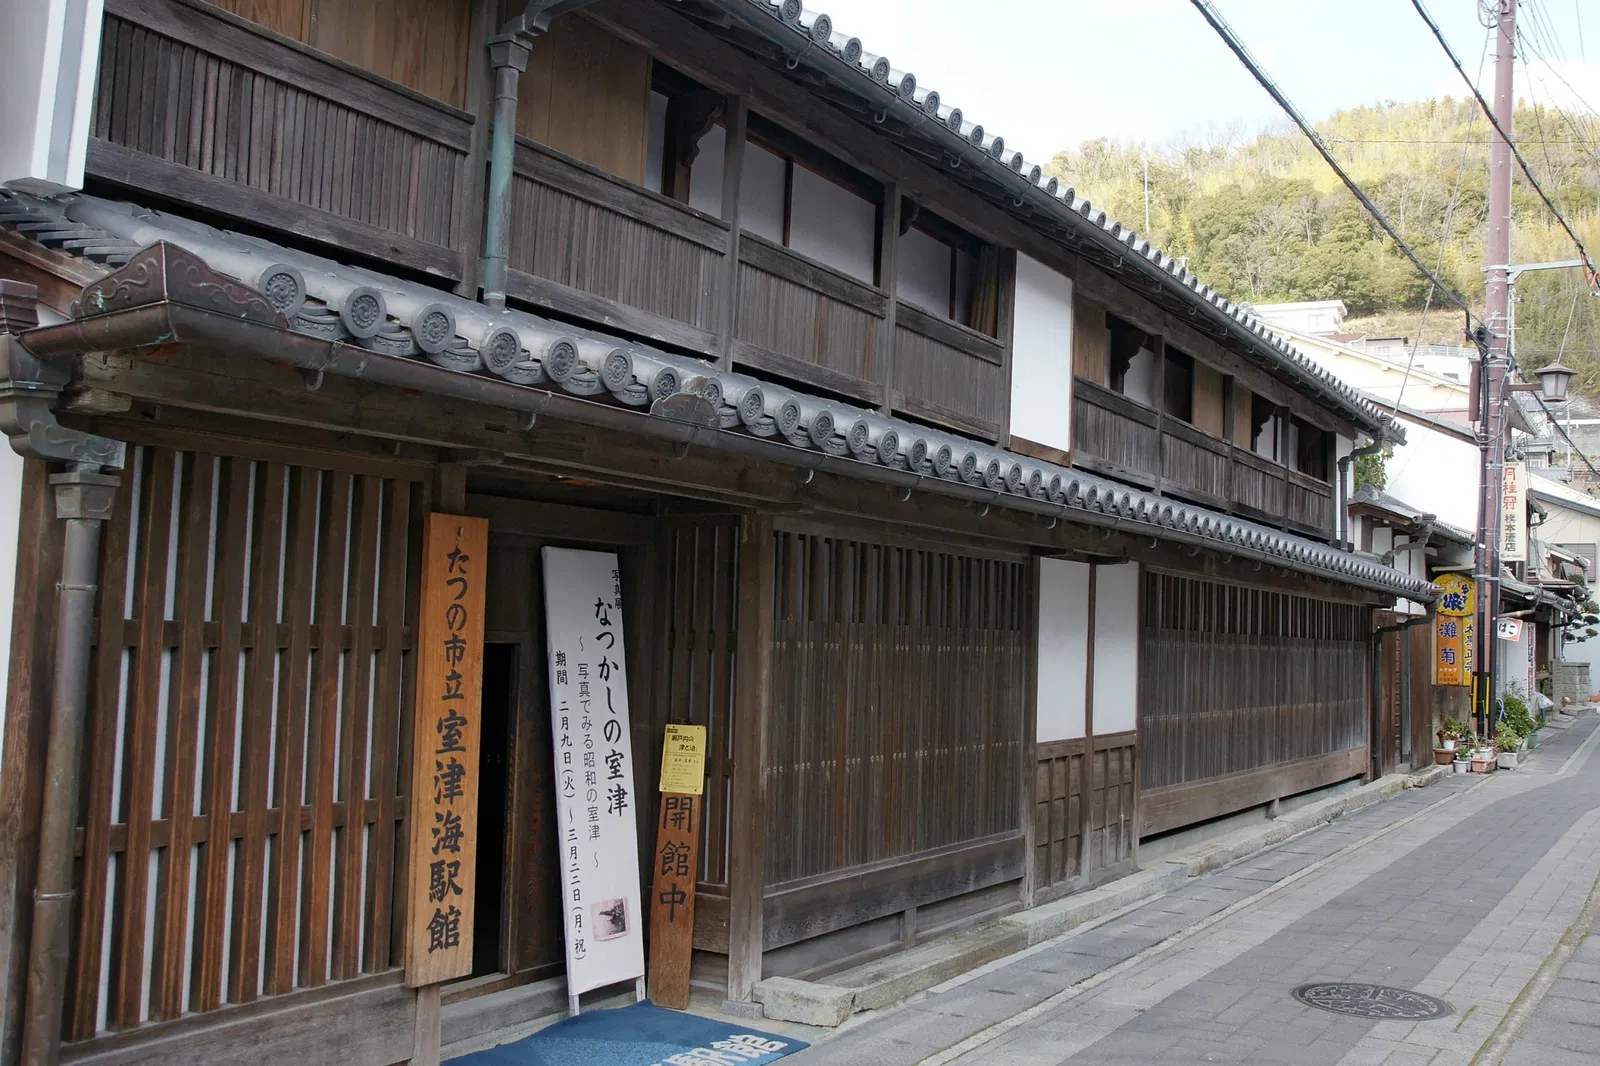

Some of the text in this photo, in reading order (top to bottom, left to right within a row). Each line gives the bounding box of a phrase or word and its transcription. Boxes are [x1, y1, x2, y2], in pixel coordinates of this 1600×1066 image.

[1503, 467, 1517, 510] 月桂冠
[555, 651, 568, 685] 期間
[1439, 622, 1457, 665] 灘菊
[595, 596, 628, 817] なつかしの室津
[426, 547, 470, 953] たつの市立室津海駅館
[659, 796, 693, 923] 開館中
